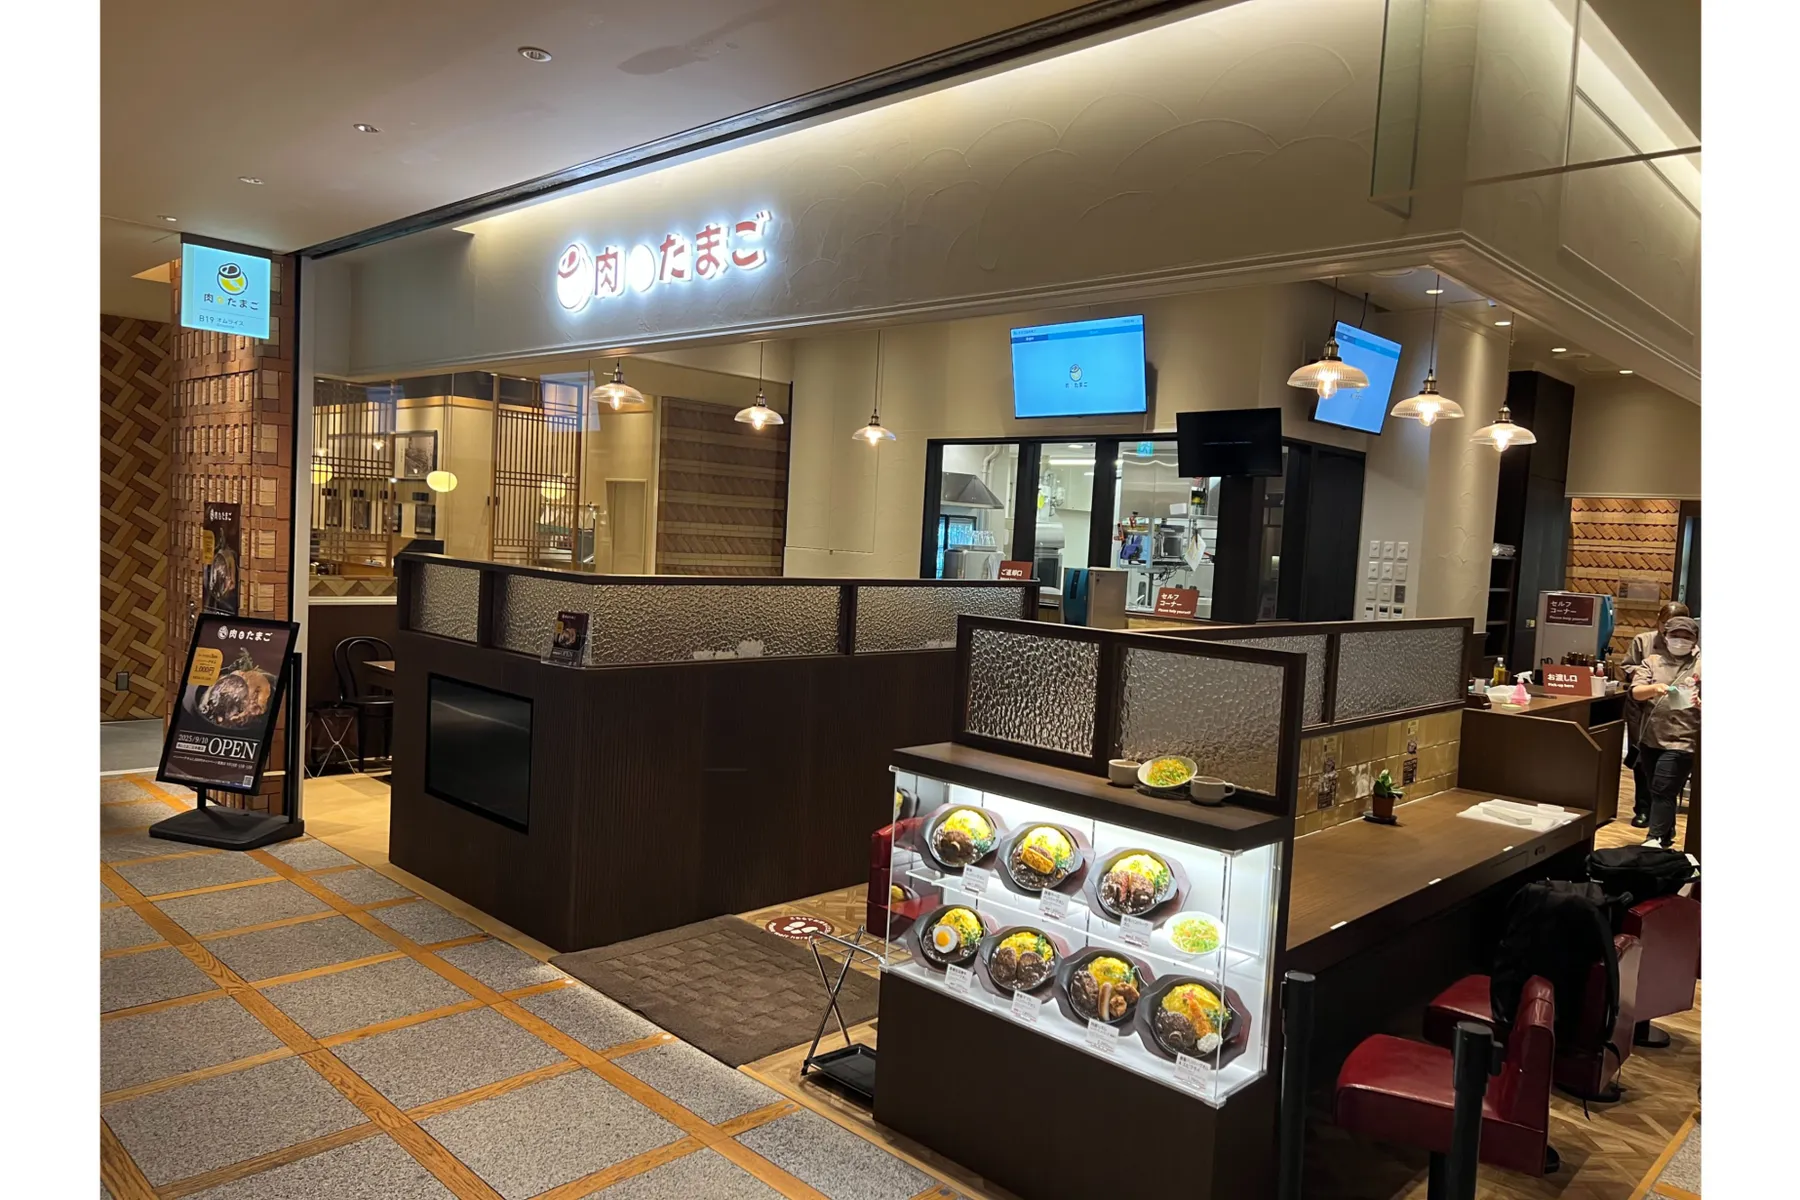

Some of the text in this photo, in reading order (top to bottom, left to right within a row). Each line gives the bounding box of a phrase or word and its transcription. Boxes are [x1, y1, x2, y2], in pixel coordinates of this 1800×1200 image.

[199, 315, 214, 323] B19
[1547, 673, 1577, 682] お渡し口
[178, 734, 208, 744] 2025/9/10
[208, 737, 258, 760] OPEN
